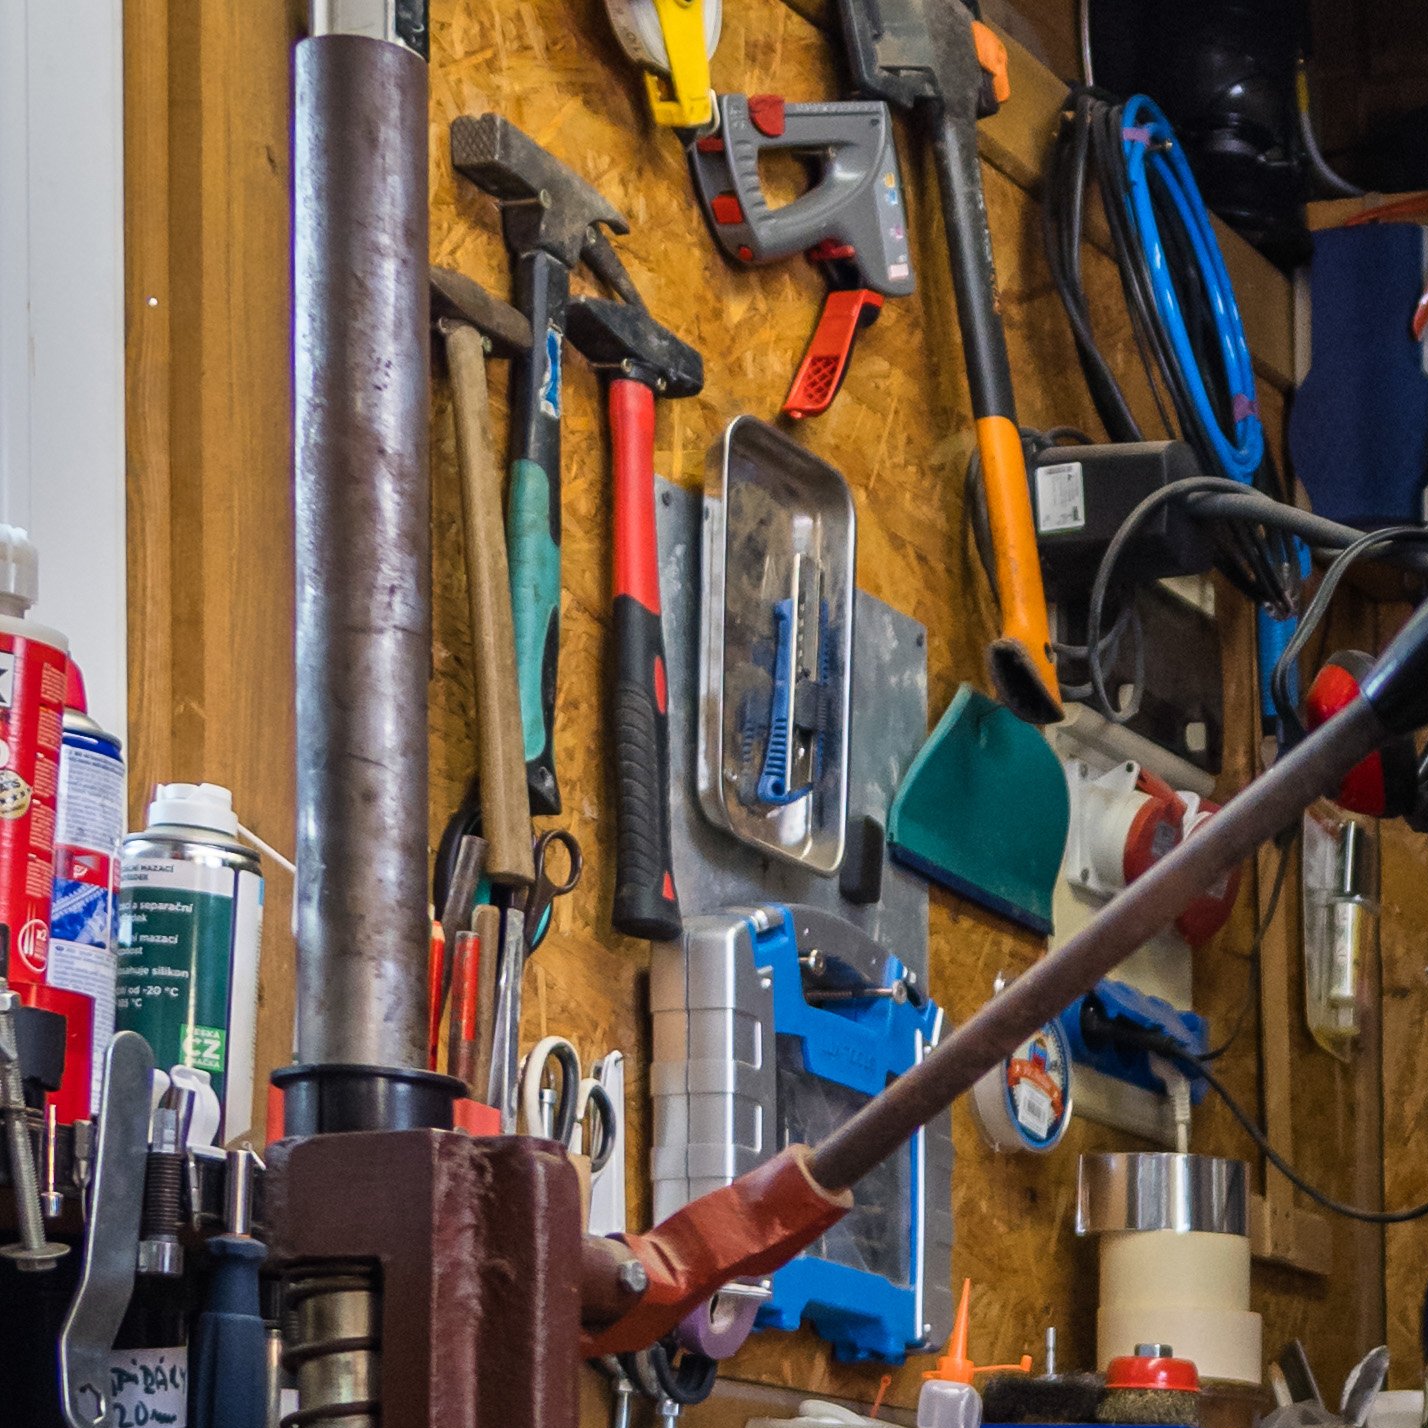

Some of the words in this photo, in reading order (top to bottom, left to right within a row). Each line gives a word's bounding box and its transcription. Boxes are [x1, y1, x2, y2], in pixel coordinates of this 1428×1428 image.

[139, 901, 193, 913] separační
[139, 934, 179, 945] mazací
[152, 966, 189, 979] silikon
[142, 986, 162, 996] -20
[184, 1038, 221, 1060] CZ
